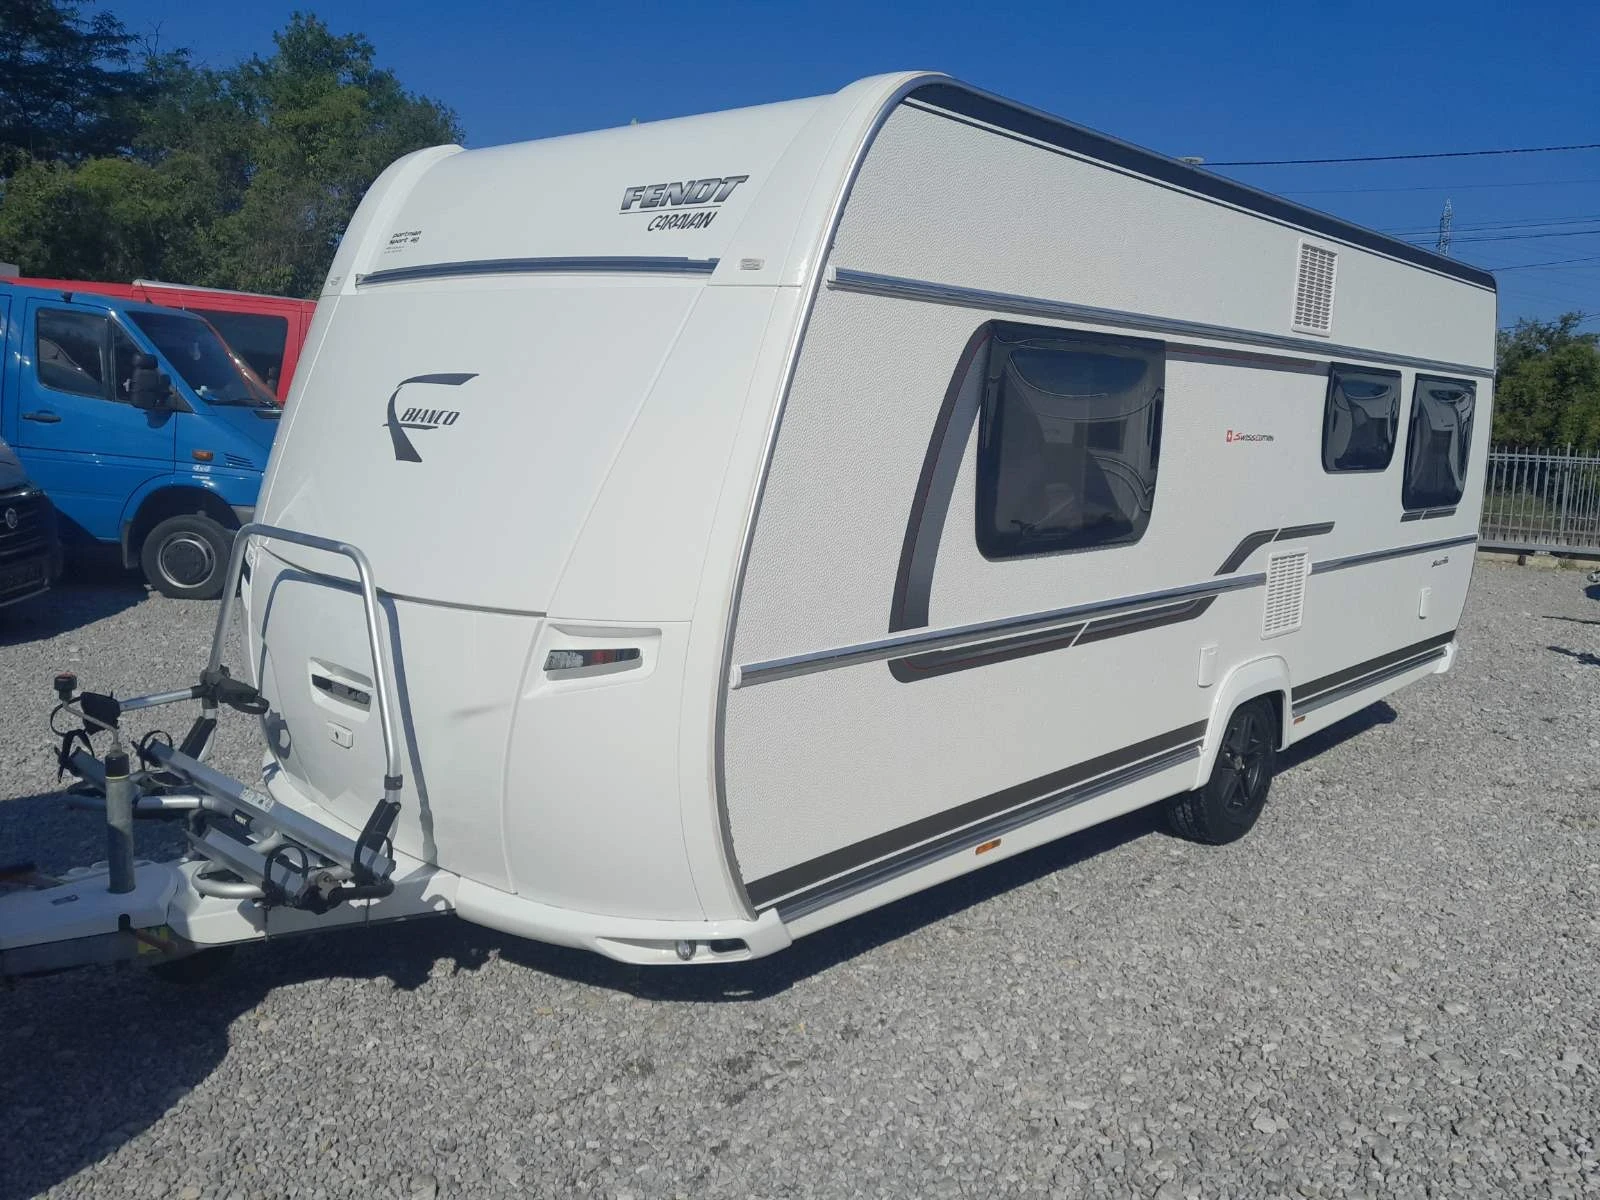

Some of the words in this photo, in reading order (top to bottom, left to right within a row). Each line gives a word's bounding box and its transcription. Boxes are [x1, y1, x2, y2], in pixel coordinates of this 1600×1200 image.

[620, 175, 750, 210] FENDT
[647, 211, 718, 231] CARAVAN
[400, 407, 460, 425] BIANCO
